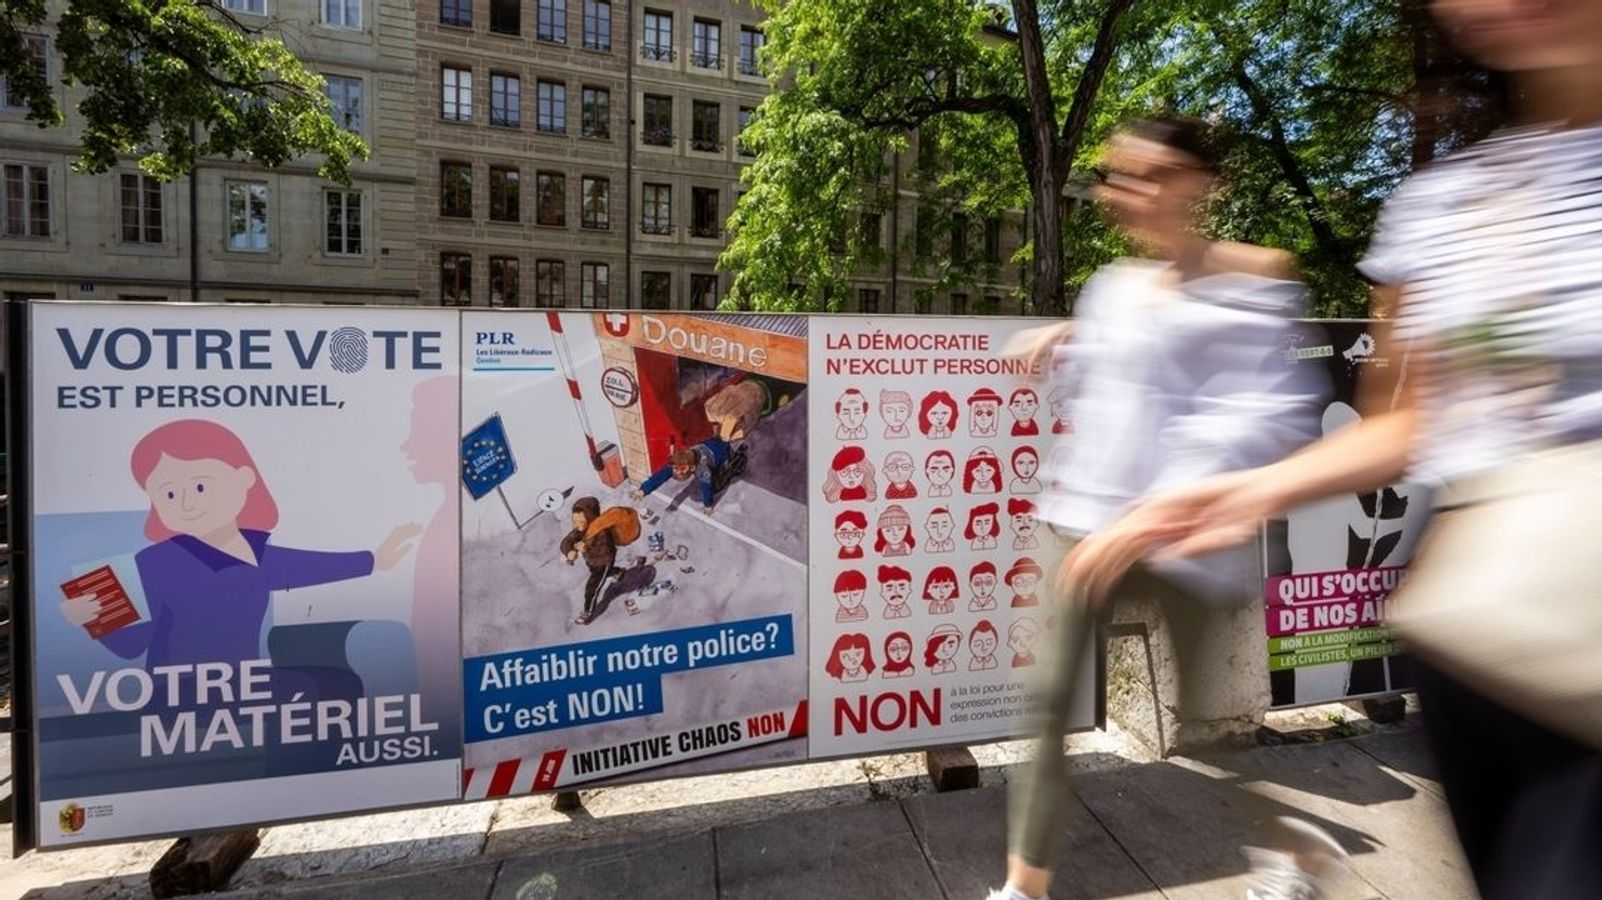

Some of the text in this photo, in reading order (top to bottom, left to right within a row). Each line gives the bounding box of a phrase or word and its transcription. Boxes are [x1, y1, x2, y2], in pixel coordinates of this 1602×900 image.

[56, 327, 272, 371] VOTRE
[476, 332, 515, 345] PLR
[642, 315, 769, 368] Douane
[826, 329, 989, 350] LA DÉMOCRATIE
[826, 358, 1041, 375] N'EXCLUT PERSONNE
[57, 384, 346, 410] EST PERSONNEL,
[1279, 577, 1318, 605] QUI
[1279, 607, 1309, 632] DE
[1314, 602, 1358, 628] NOS
[480, 622, 779, 692] Affaiblir notre police?
[1281, 638, 1302, 651] NON
[1312, 635, 1323, 646] LA
[1281, 655, 1297, 667] LES
[57, 658, 273, 715] VOTRE
[959, 687, 967, 695] la
[969, 685, 980, 694] loi
[982, 683, 1004, 694] pour
[483, 683, 644, 734] C'est NON!
[834, 688, 942, 736] NON
[950, 696, 1001, 710] expression
[1003, 695, 1022, 704] non
[950, 711, 968, 723] des
[970, 708, 1022, 720] convictions
[139, 691, 439, 758] MATÉRIEL
[335, 736, 439, 766] AUSSI.
[572, 735, 672, 776] INITIATIVE
[678, 720, 741, 753] CHAOS
[747, 711, 785, 738] NON
